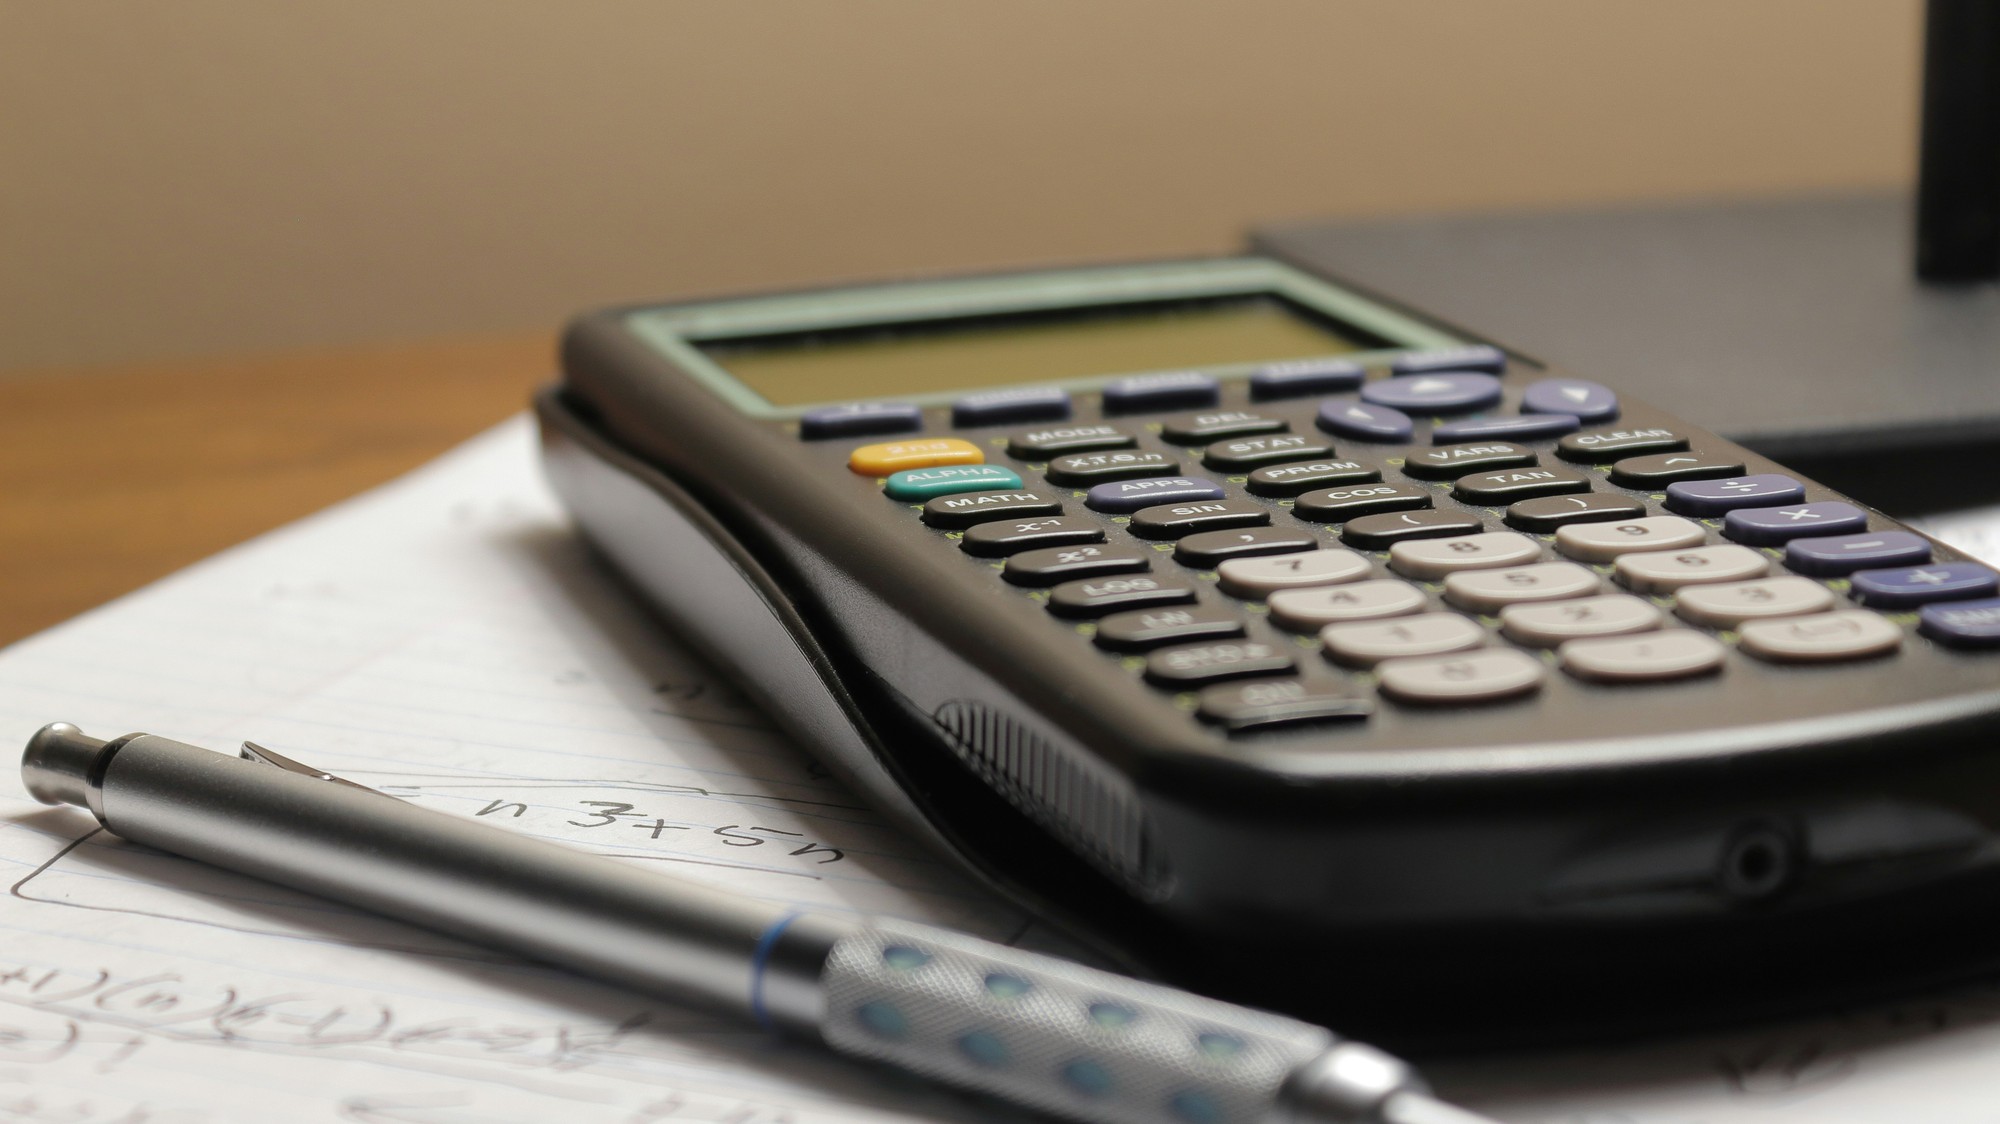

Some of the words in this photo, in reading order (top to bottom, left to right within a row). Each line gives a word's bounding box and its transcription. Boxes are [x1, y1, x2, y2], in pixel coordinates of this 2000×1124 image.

[1197, 412, 1260, 425] DEL
[1027, 426, 1117, 442] MODE
[1577, 429, 1673, 444] CLEAR
[1229, 437, 1305, 451] STAT
[1428, 446, 1514, 459] VARS
[907, 468, 1001, 482] ALPHA
[1265, 461, 1361, 478] PRGM
[1486, 471, 1556, 483] TAN
[1122, 479, 1195, 492] APPS
[945, 493, 1040, 508] MATH
[1328, 487, 1398, 500] COS
[1171, 504, 1227, 515] SIN
[1082, 578, 1158, 596] LOG
